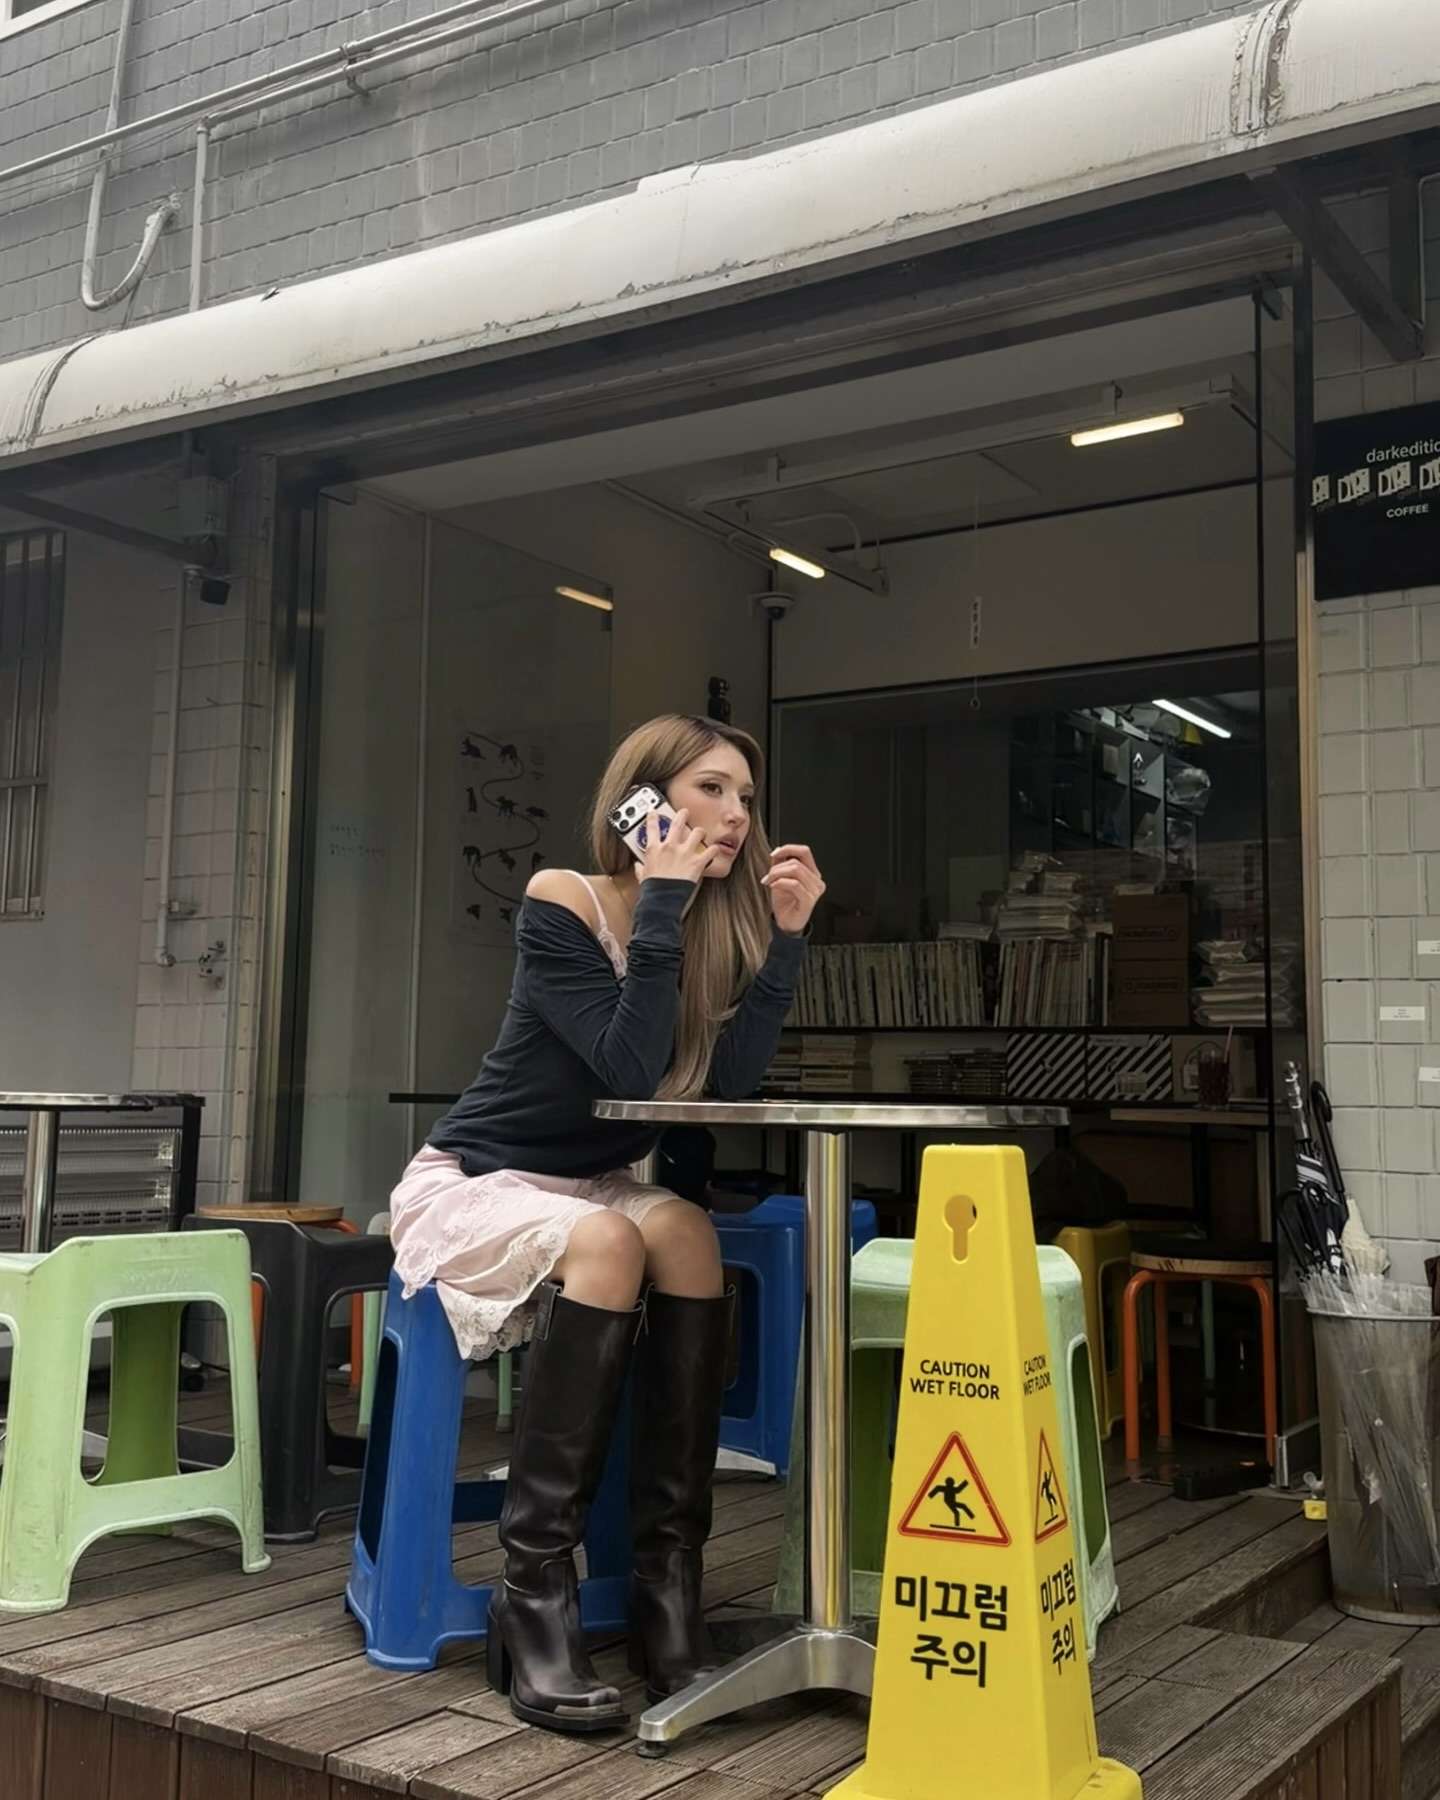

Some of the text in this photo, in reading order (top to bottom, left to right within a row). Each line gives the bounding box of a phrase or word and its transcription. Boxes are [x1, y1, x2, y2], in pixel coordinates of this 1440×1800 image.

[1386, 503, 1429, 518] COFFEE
[920, 1359, 990, 1379] CAUTION
[1024, 1354, 1046, 1376] CAUTION
[910, 1378, 1000, 1400] WET FLOOR
[1023, 1372, 1052, 1396] WET FLOOR
[1040, 1558, 1077, 1621] 미끄럼
[895, 1575, 1007, 1631] 미끄럼
[1052, 1617, 1077, 1675] 주의
[910, 1634, 986, 1688] 주의
